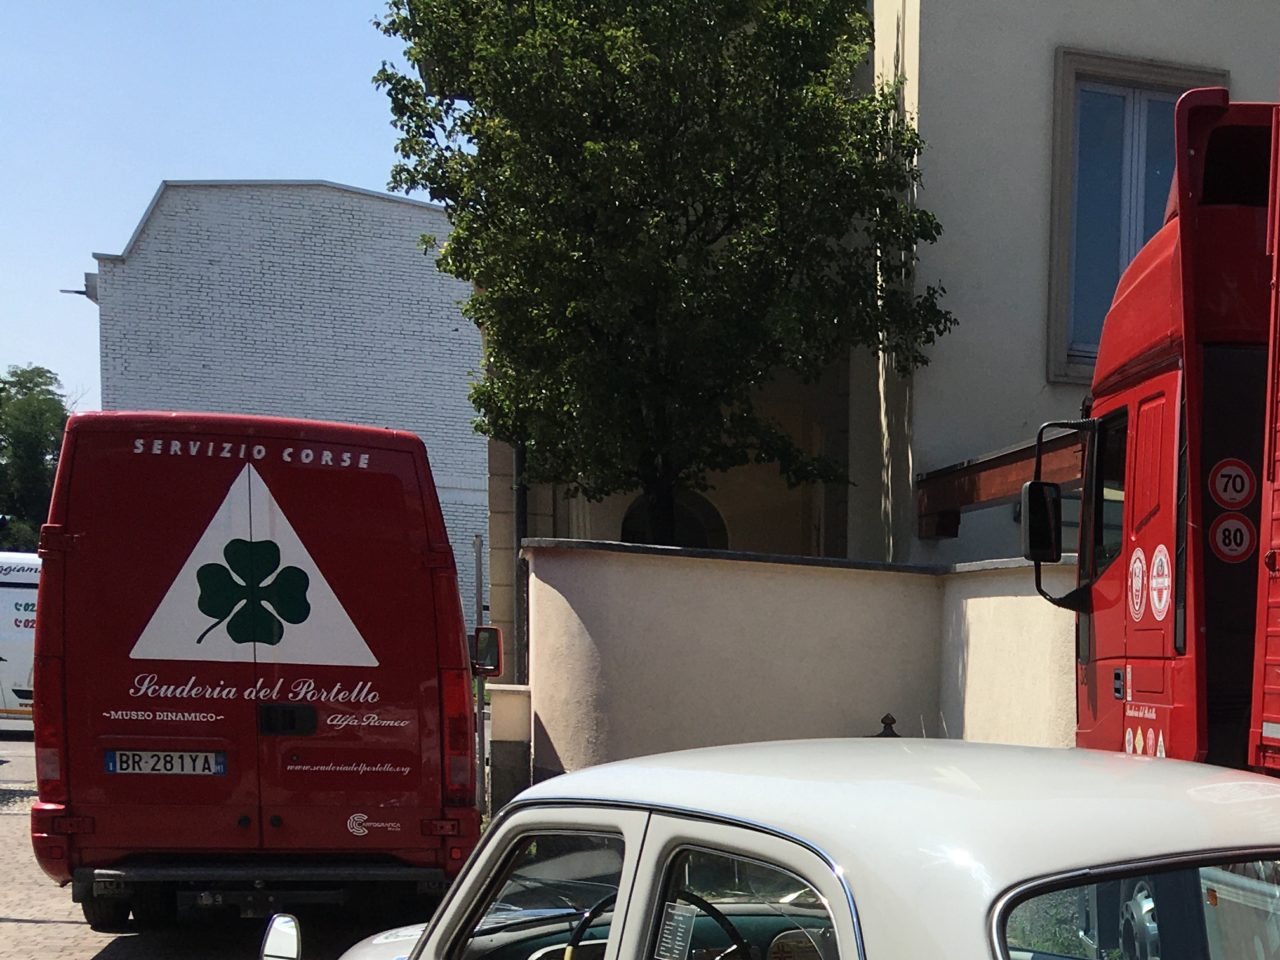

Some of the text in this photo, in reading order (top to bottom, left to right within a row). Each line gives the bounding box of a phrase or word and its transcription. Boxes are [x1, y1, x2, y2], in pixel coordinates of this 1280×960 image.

[133, 438, 370, 469] SERVIZIO CORSE
[1220, 473, 1245, 494] 70
[1222, 528, 1244, 548] 80
[128, 673, 381, 704] Scuderia del Portello
[326, 714, 410, 728] Alfa Romeo
